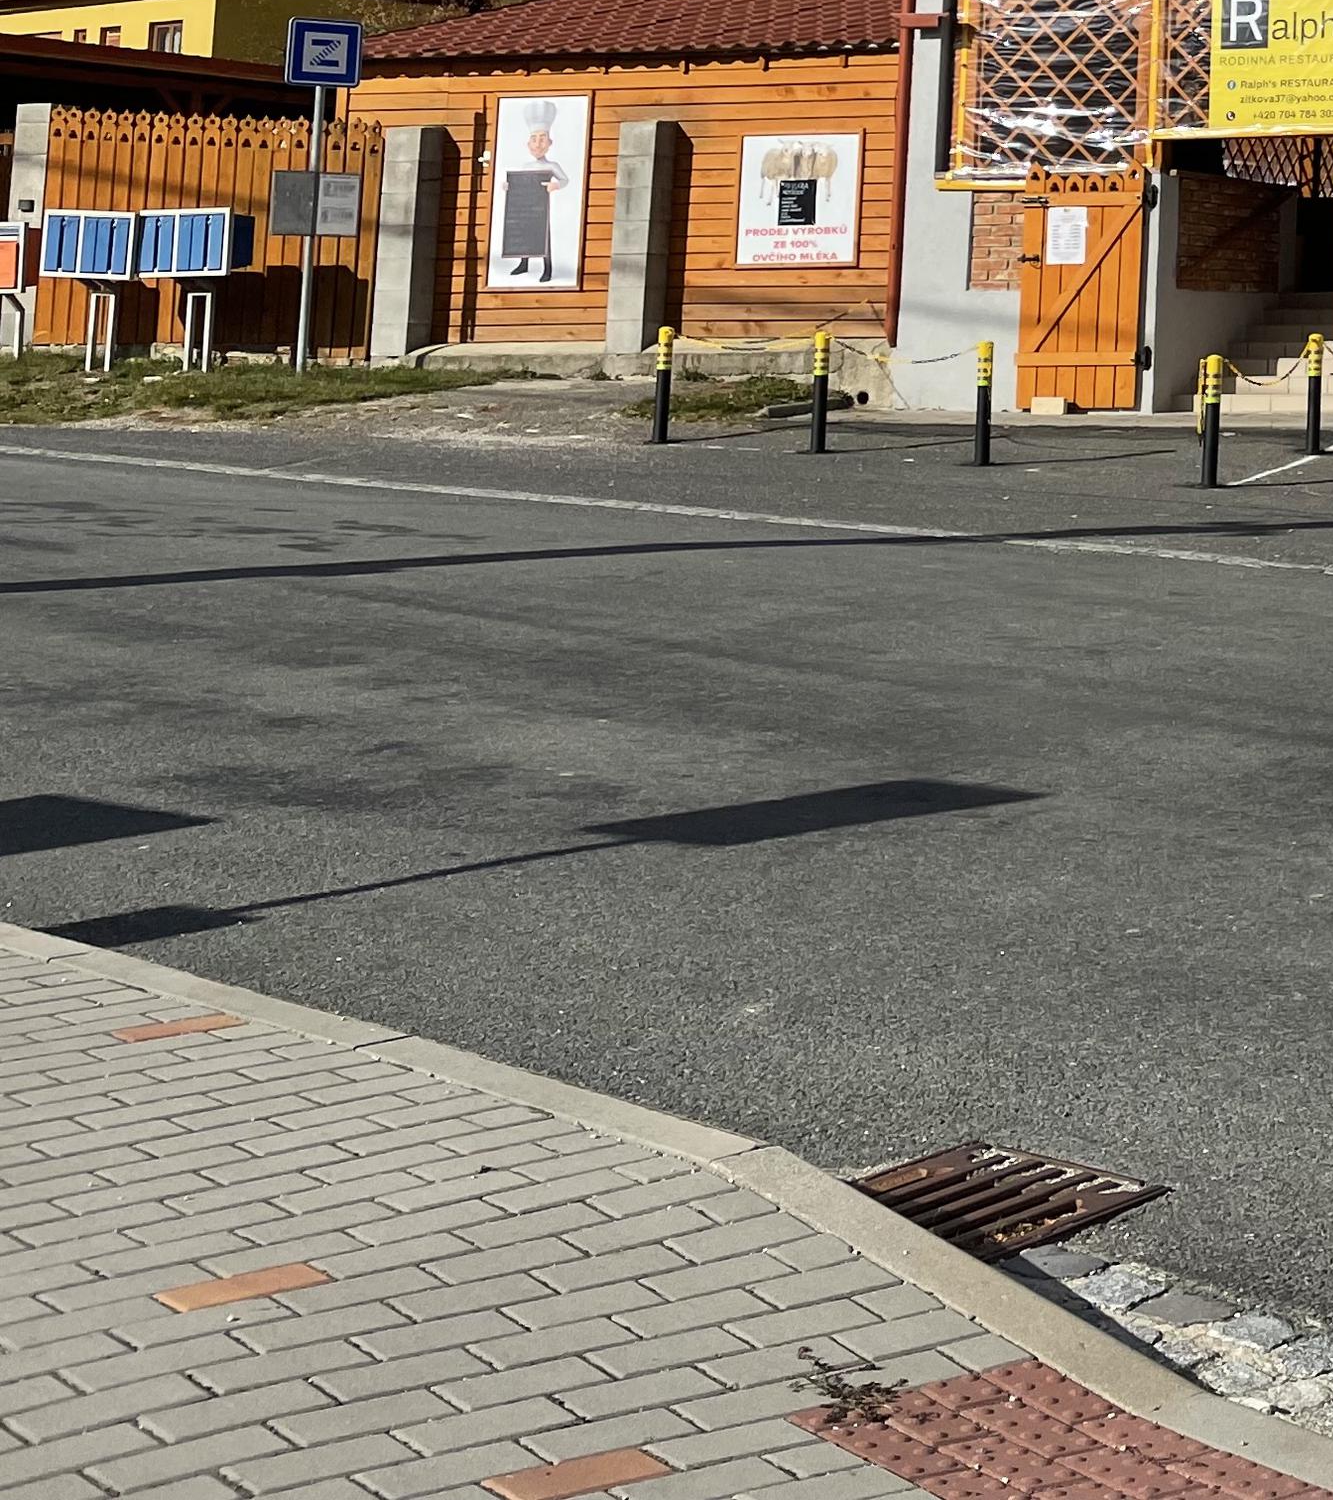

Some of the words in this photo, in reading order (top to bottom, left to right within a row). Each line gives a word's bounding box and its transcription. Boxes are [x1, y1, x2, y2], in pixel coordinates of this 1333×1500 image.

[1240, 79, 1277, 90] Ralph's
[745, 228, 789, 237] PRODEJ
[773, 241, 787, 249] ZE
